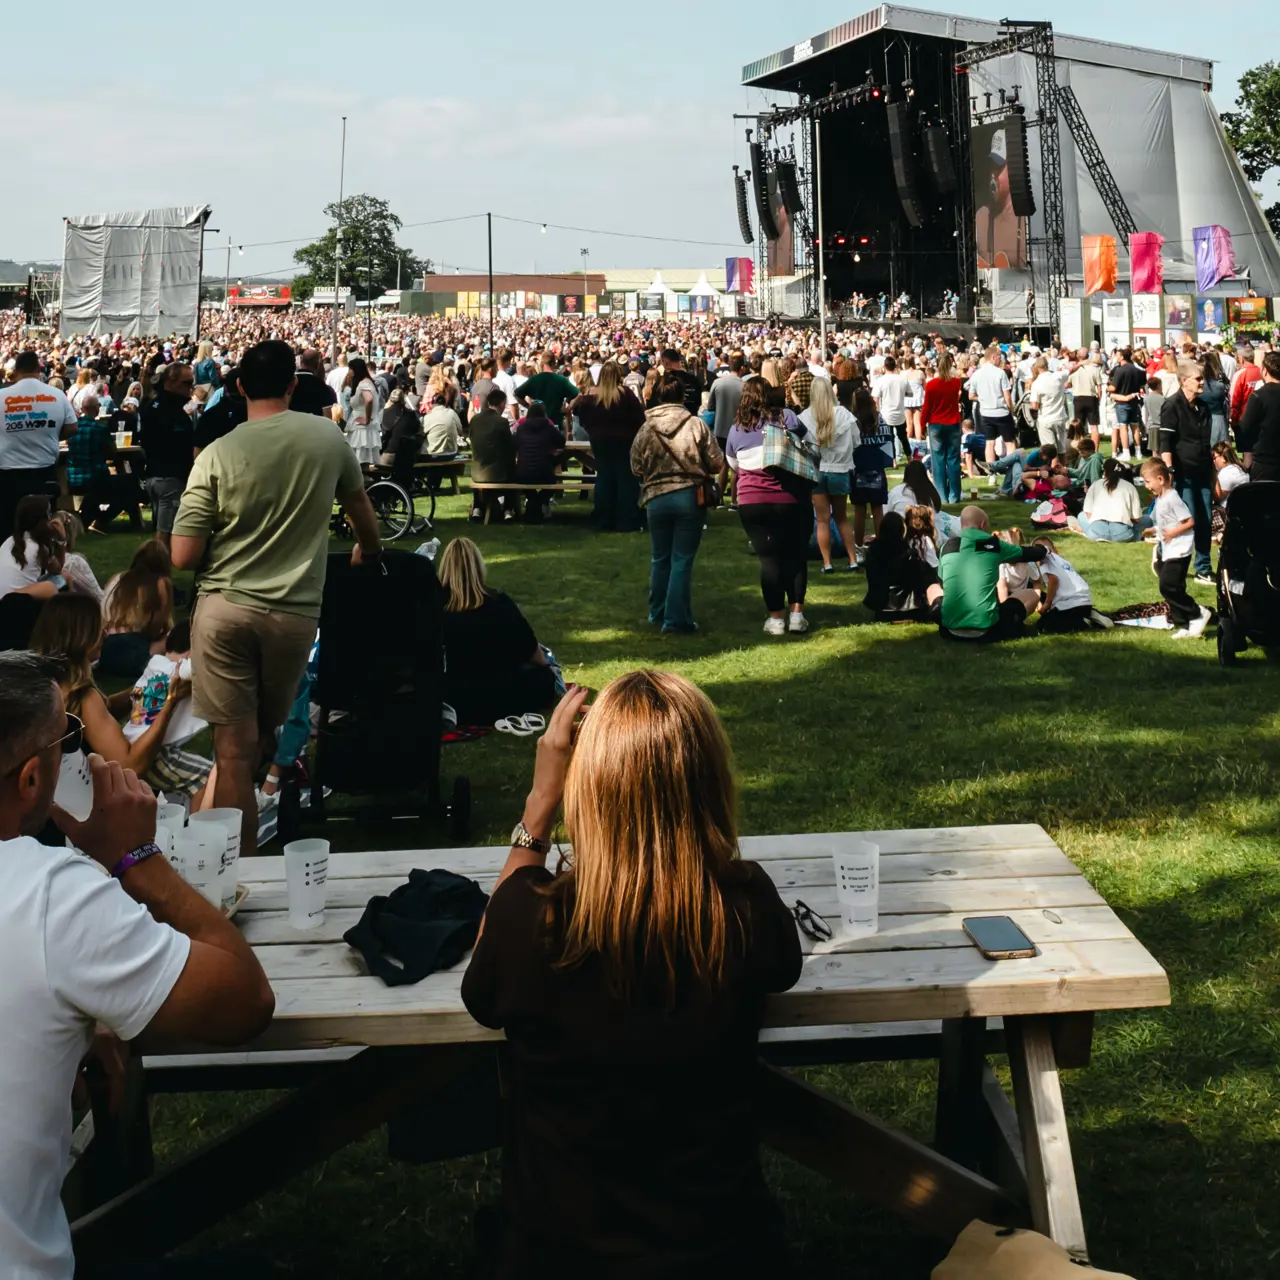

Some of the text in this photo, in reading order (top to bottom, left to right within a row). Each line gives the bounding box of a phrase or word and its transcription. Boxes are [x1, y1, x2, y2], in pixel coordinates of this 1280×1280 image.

[28, 412, 48, 420] York
[6, 422, 24, 430] 205
[26, 420, 47, 428] W39
